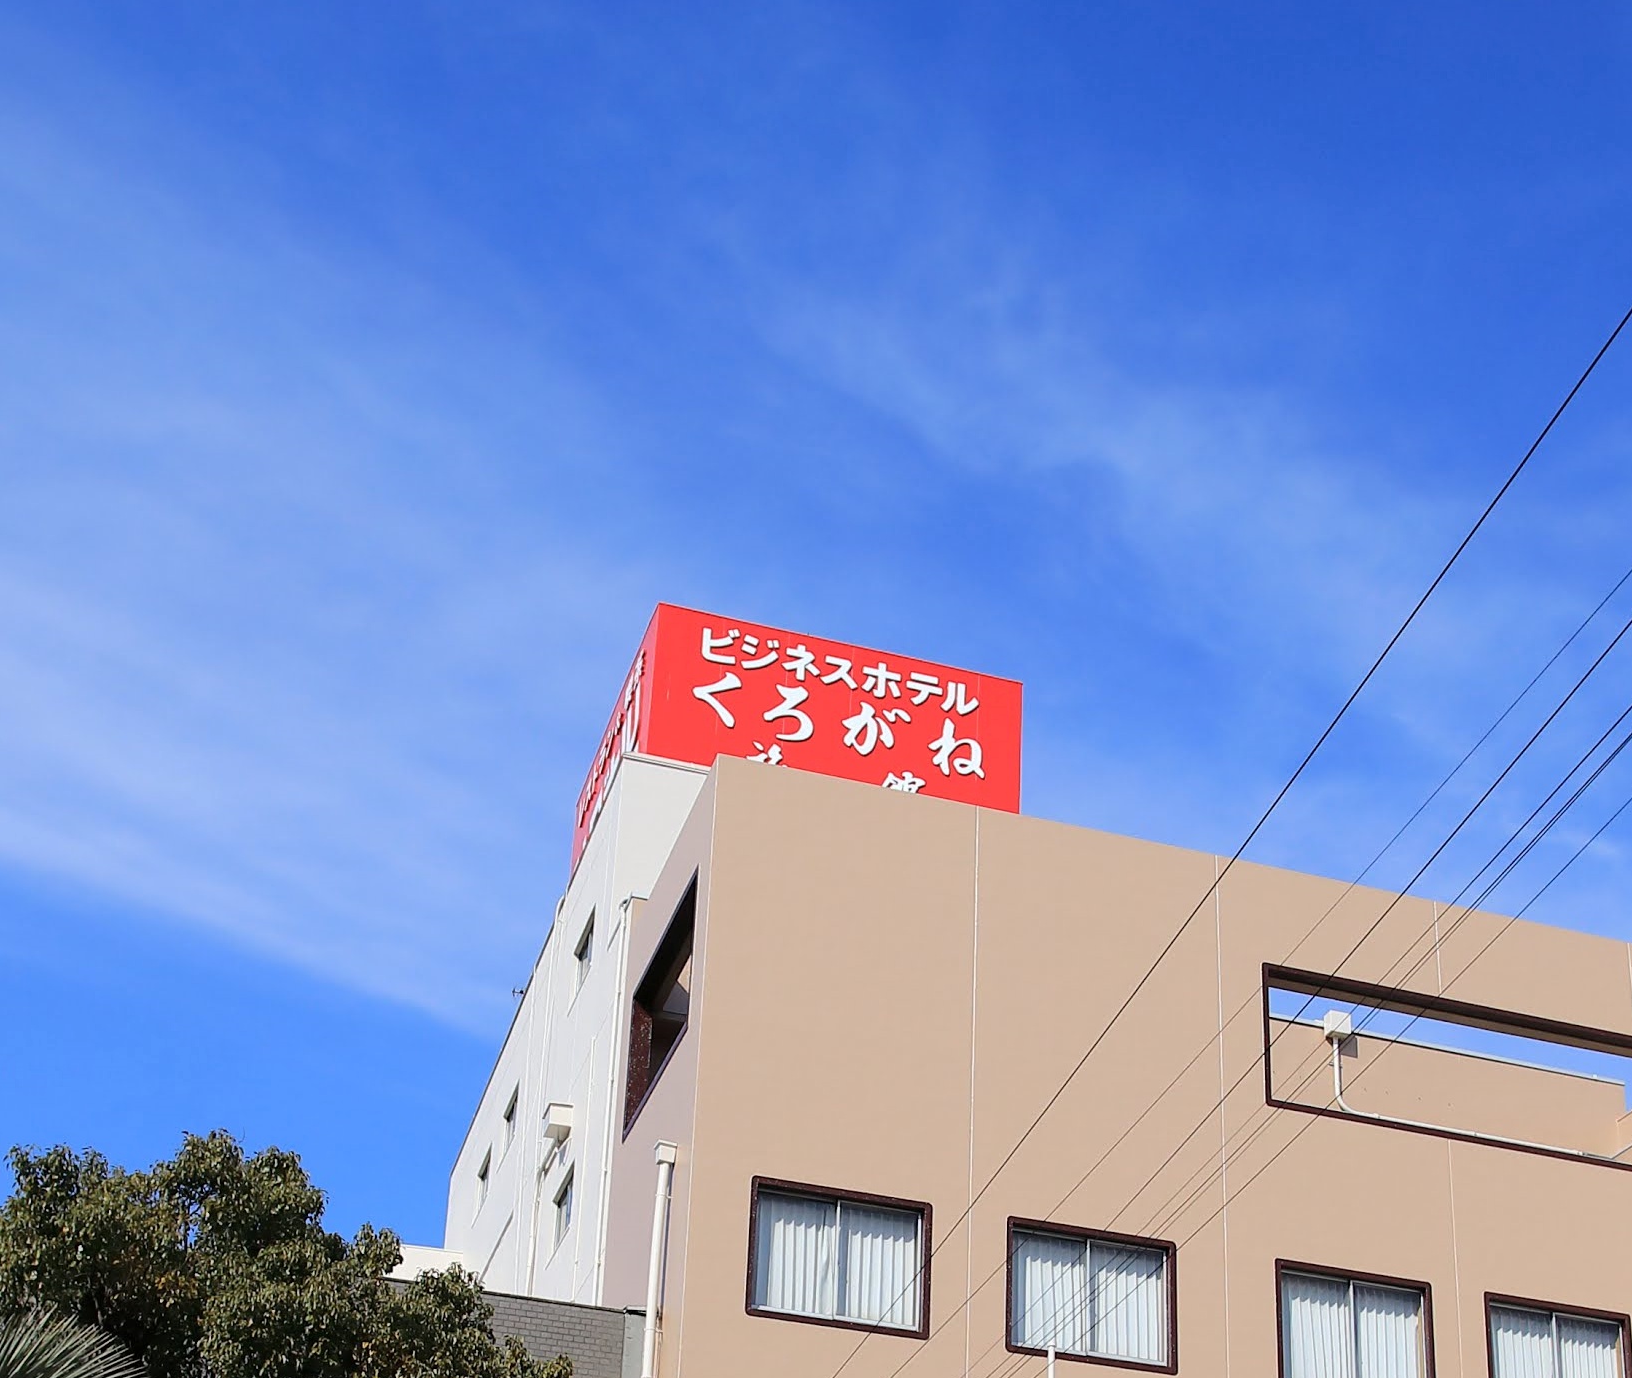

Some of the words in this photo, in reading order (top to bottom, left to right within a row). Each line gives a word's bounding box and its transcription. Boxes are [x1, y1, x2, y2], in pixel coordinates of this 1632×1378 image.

[700, 626, 980, 715] ビジネスホテル
[692, 671, 987, 780] くろがね
